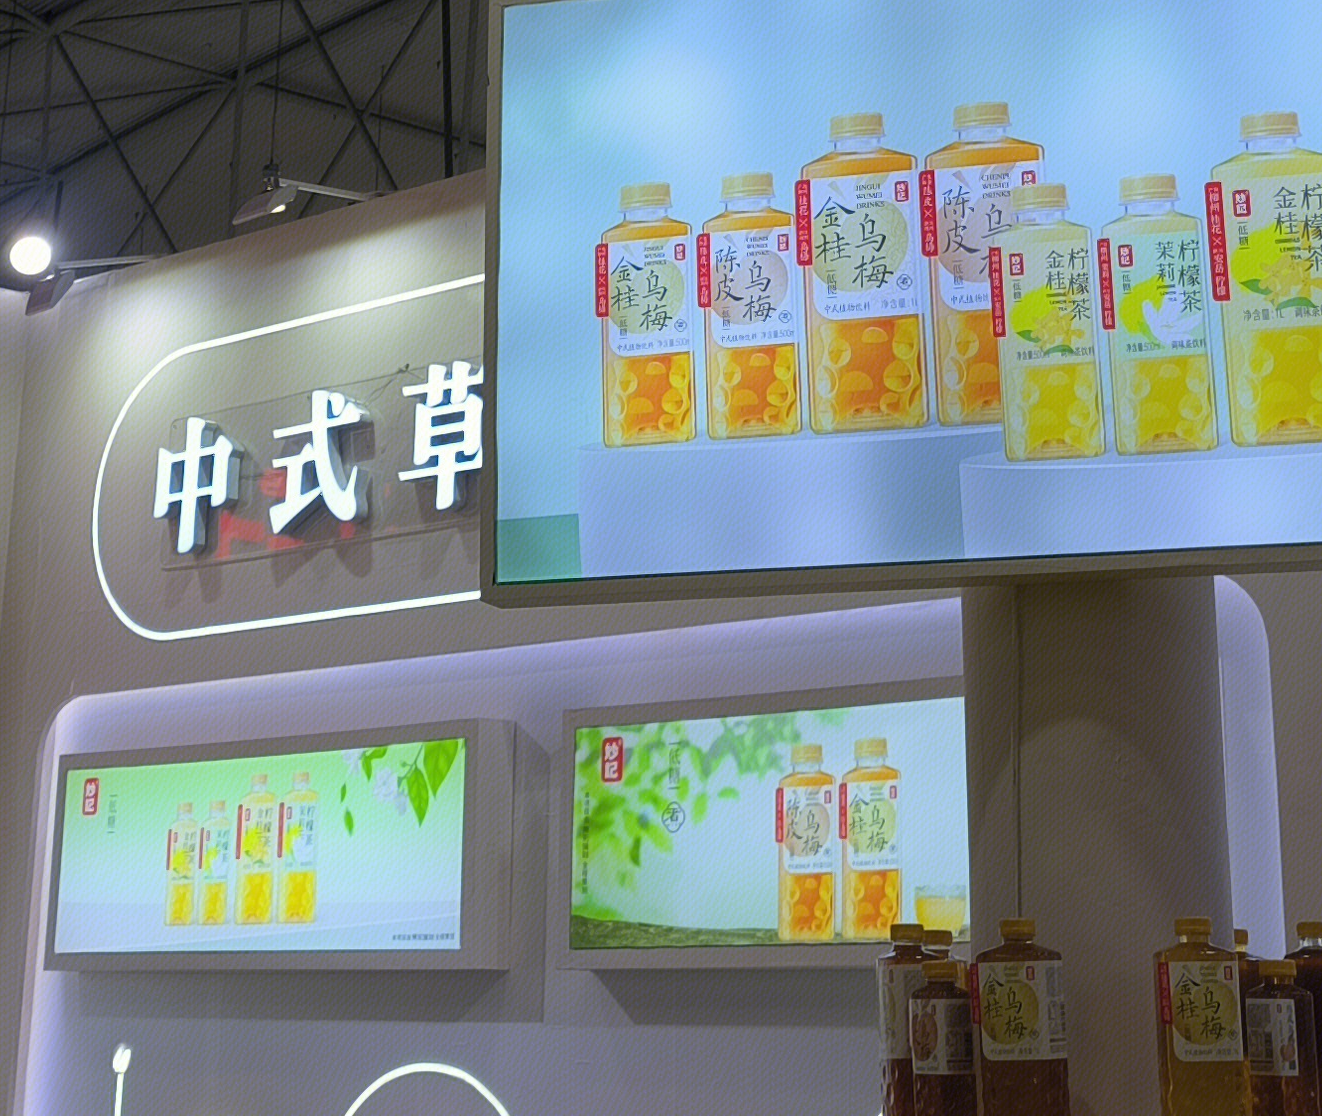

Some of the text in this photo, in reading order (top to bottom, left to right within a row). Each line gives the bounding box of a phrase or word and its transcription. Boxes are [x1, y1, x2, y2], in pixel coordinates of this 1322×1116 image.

[814, 196, 855, 263] 金桂
[942, 185, 981, 254] 陈皮
[1273, 186, 1299, 235] 金桂
[714, 246, 744, 302] 陈皮
[852, 213, 894, 288] 乌梅
[1045, 250, 1066, 290] 金桂
[1156, 241, 1175, 282] 茉莉
[1178, 239, 1202, 313] 柠檬茶
[610, 256, 644, 312] 金桂
[639, 269, 673, 331] 乌梅
[743, 260, 777, 322] 乌梅
[1067, 247, 1091, 321] 柠檬茶
[153, 360, 484, 553] 中式草
[802, 809, 823, 856] 乌梅
[849, 793, 870, 835] 金桂
[866, 805, 889, 852] 乌梅
[983, 973, 1004, 1019] 金桂
[1005, 987, 1027, 1040] 乌梅
[1175, 972, 1201, 1019] 金桂
[1200, 987, 1226, 1040] 乌梅
